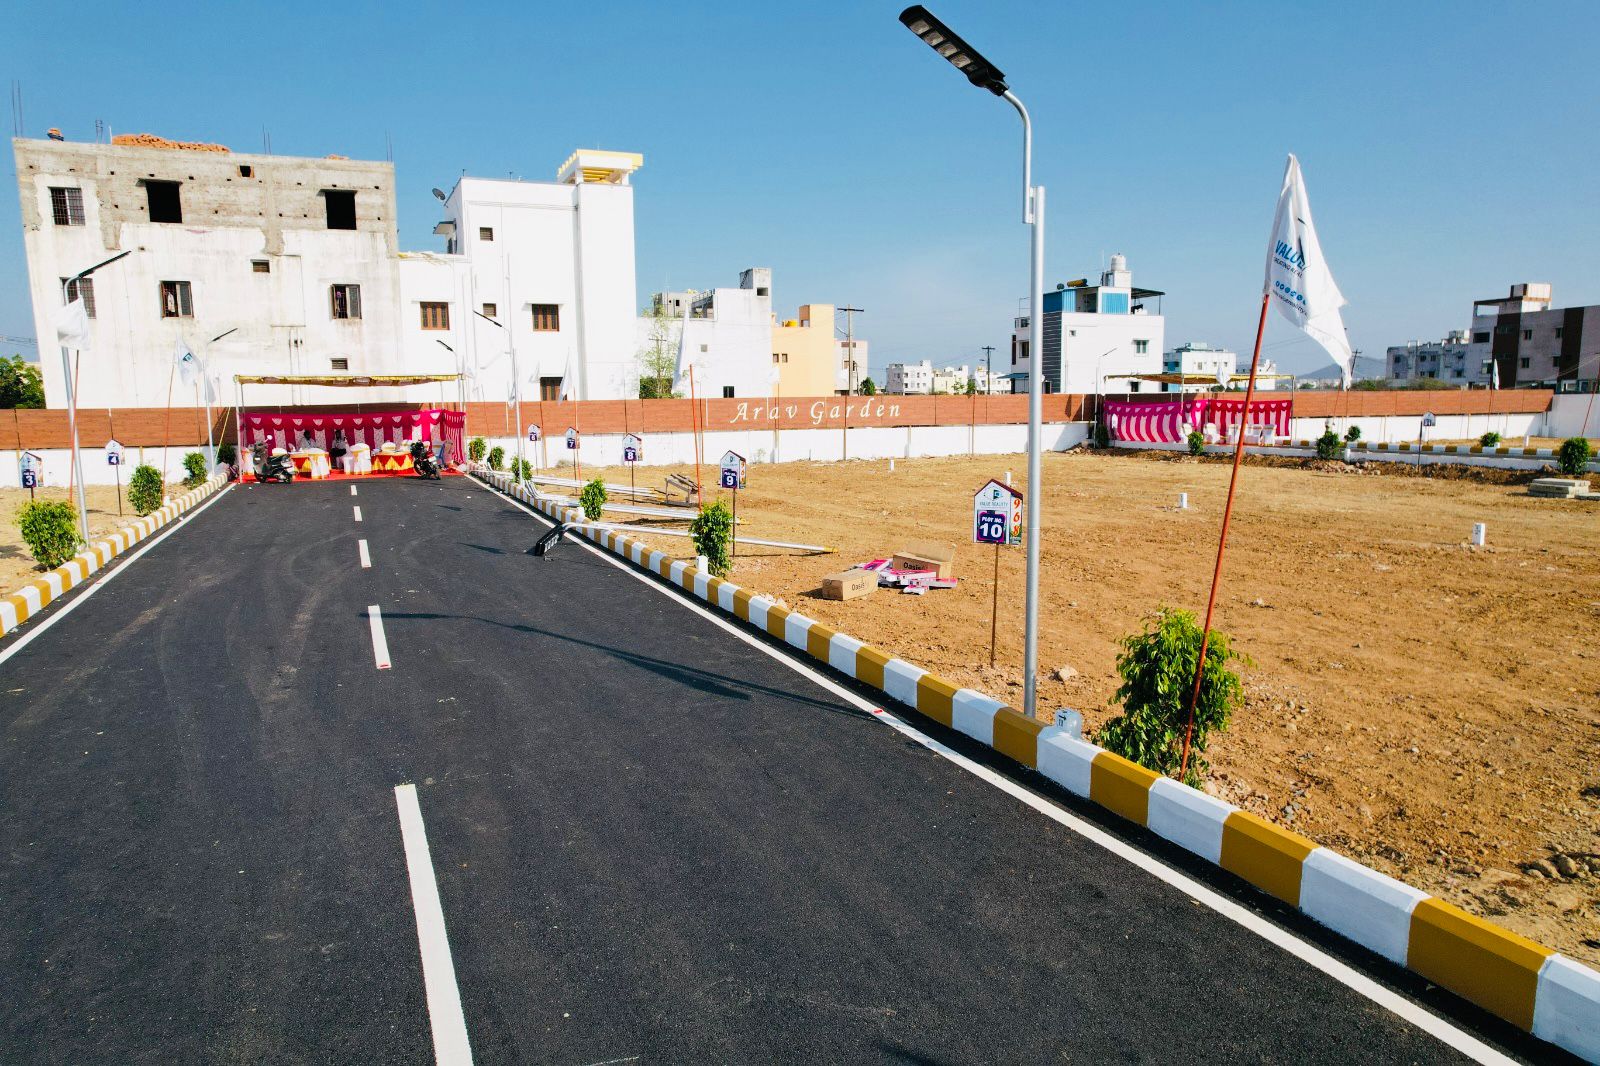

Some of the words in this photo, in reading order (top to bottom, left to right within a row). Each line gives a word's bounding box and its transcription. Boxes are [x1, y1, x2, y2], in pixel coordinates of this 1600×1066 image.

[730, 402, 798, 424] Arav
[810, 398, 901, 425] Garden
[110, 456, 117, 465] 4
[25, 475, 33, 486] 3
[726, 475, 734, 486] 9
[979, 522, 1003, 538] 10
